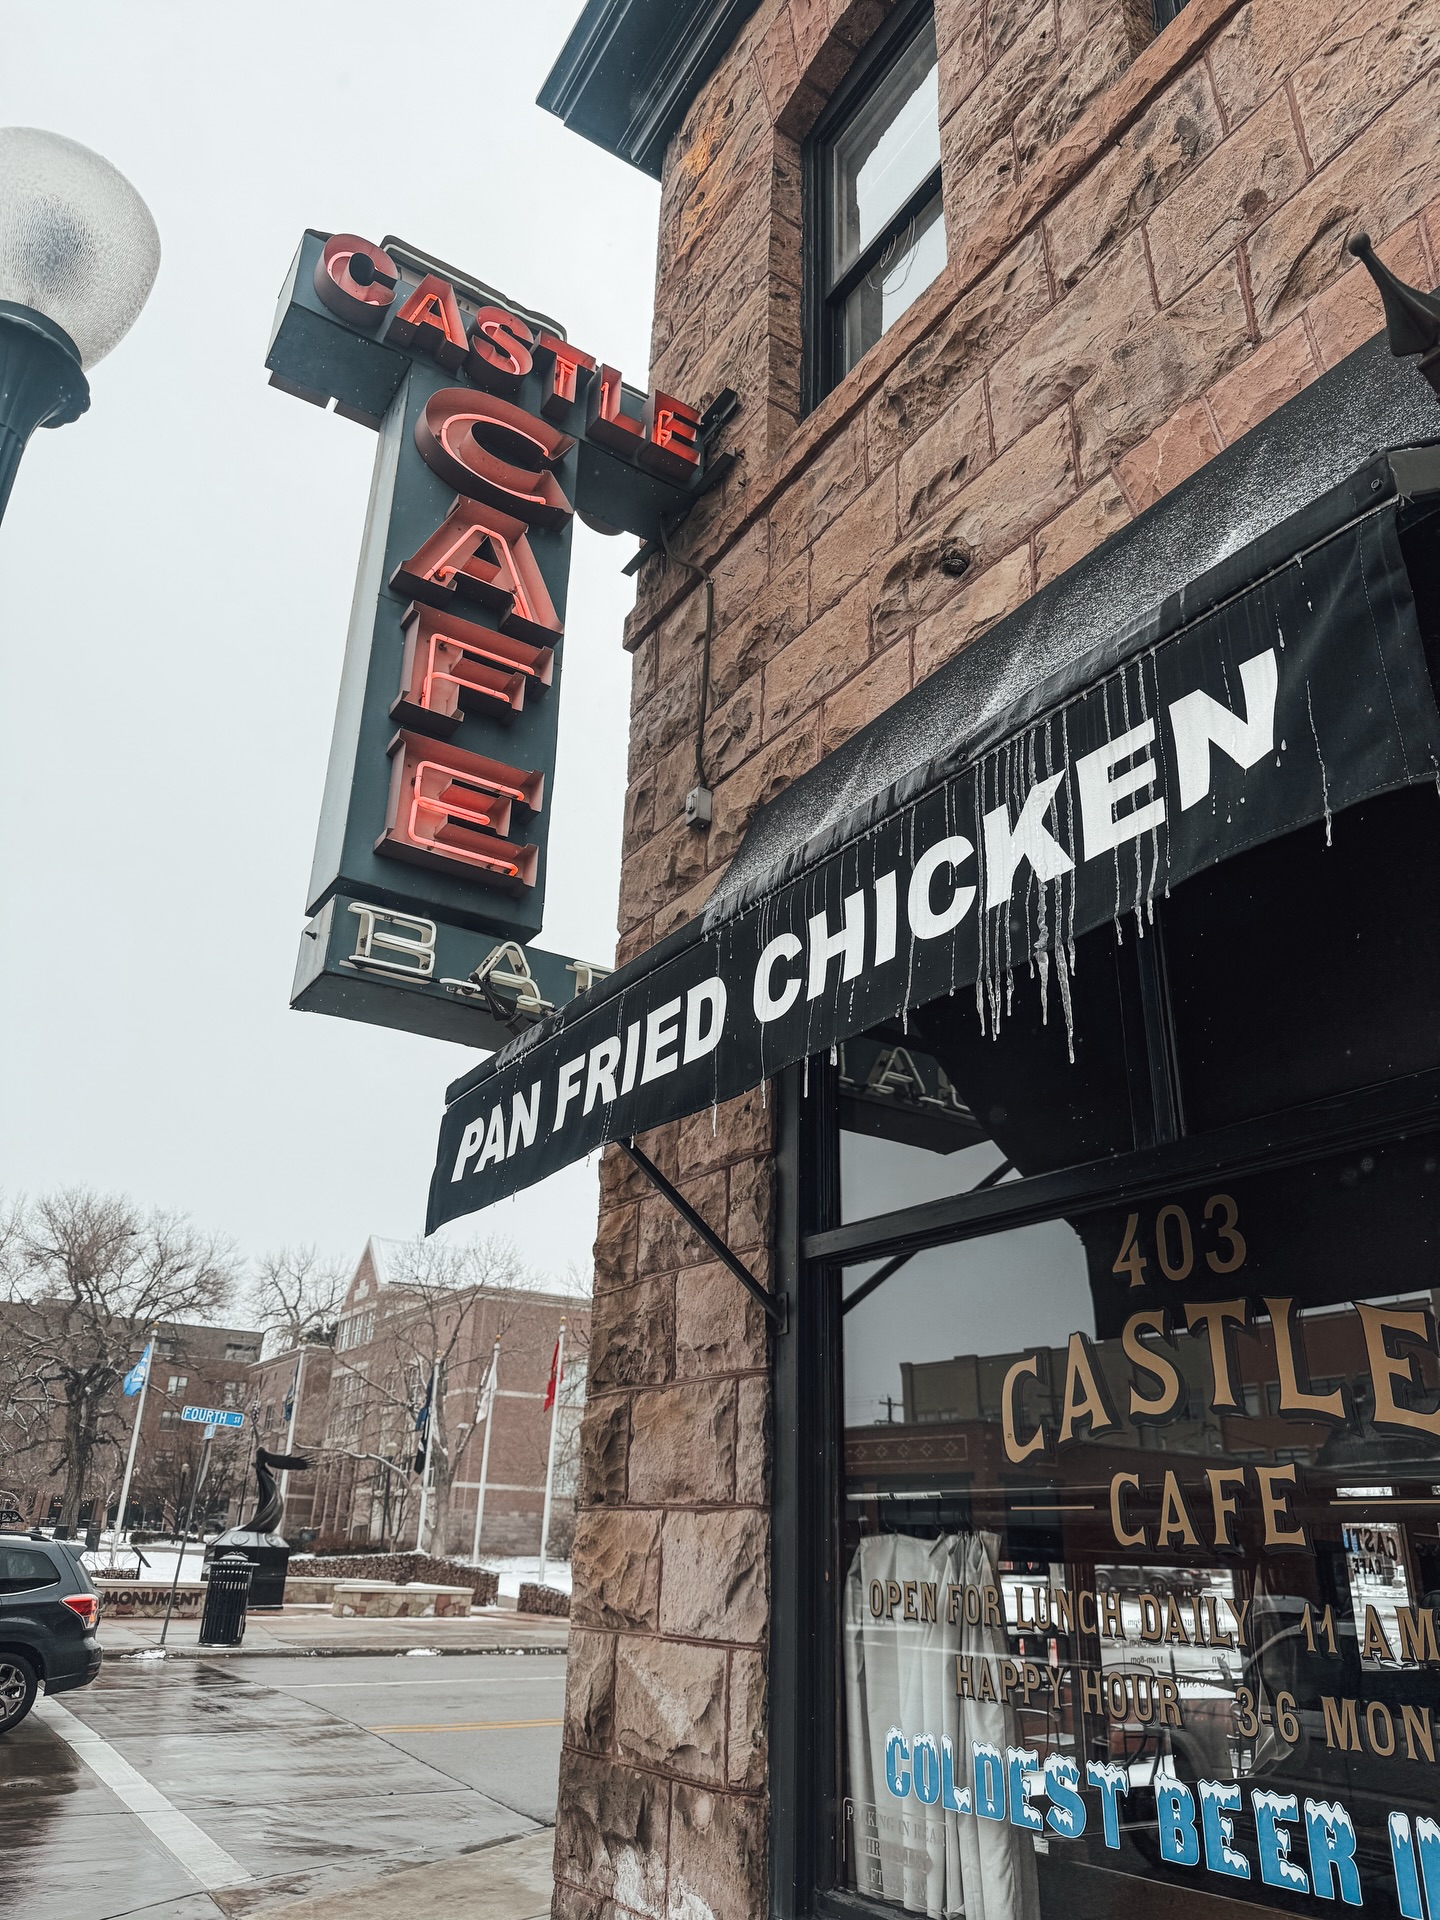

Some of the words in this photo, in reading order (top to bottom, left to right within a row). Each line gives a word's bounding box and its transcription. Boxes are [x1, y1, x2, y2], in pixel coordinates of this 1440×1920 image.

[314, 233, 702, 482] CASTLE
[374, 387, 577, 889] CAFE
[339, 901, 615, 1016] BA
[450, 1080, 541, 1183] PAN
[552, 976, 727, 1133] FRIED
[752, 648, 1279, 1023] CHICKEN
[1112, 1194, 1247, 1288] 403
[184, 1408, 228, 1424] FOURTH
[1002, 1295, 1440, 1464] CASTLE
[1110, 1463, 1308, 1550] CAFE
[103, 1590, 203, 1606] MONUMENT
[869, 1579, 937, 1624] OPEN
[947, 1583, 1001, 1628] FOR
[1014, 1586, 1125, 1638] LUNCH
[1138, 1593, 1250, 1650] DAILY
[1300, 1602, 1340, 1654] 11
[1361, 1603, 1440, 1662] AM
[955, 1654, 1064, 1712] HAPPY
[1080, 1669, 1184, 1730] HOUR
[1236, 1686, 1299, 1744] 3-6
[1320, 1694, 1436, 1763] MON
[885, 1725, 1130, 1850] COLDEST
[1154, 1771, 1364, 1906] BEER
